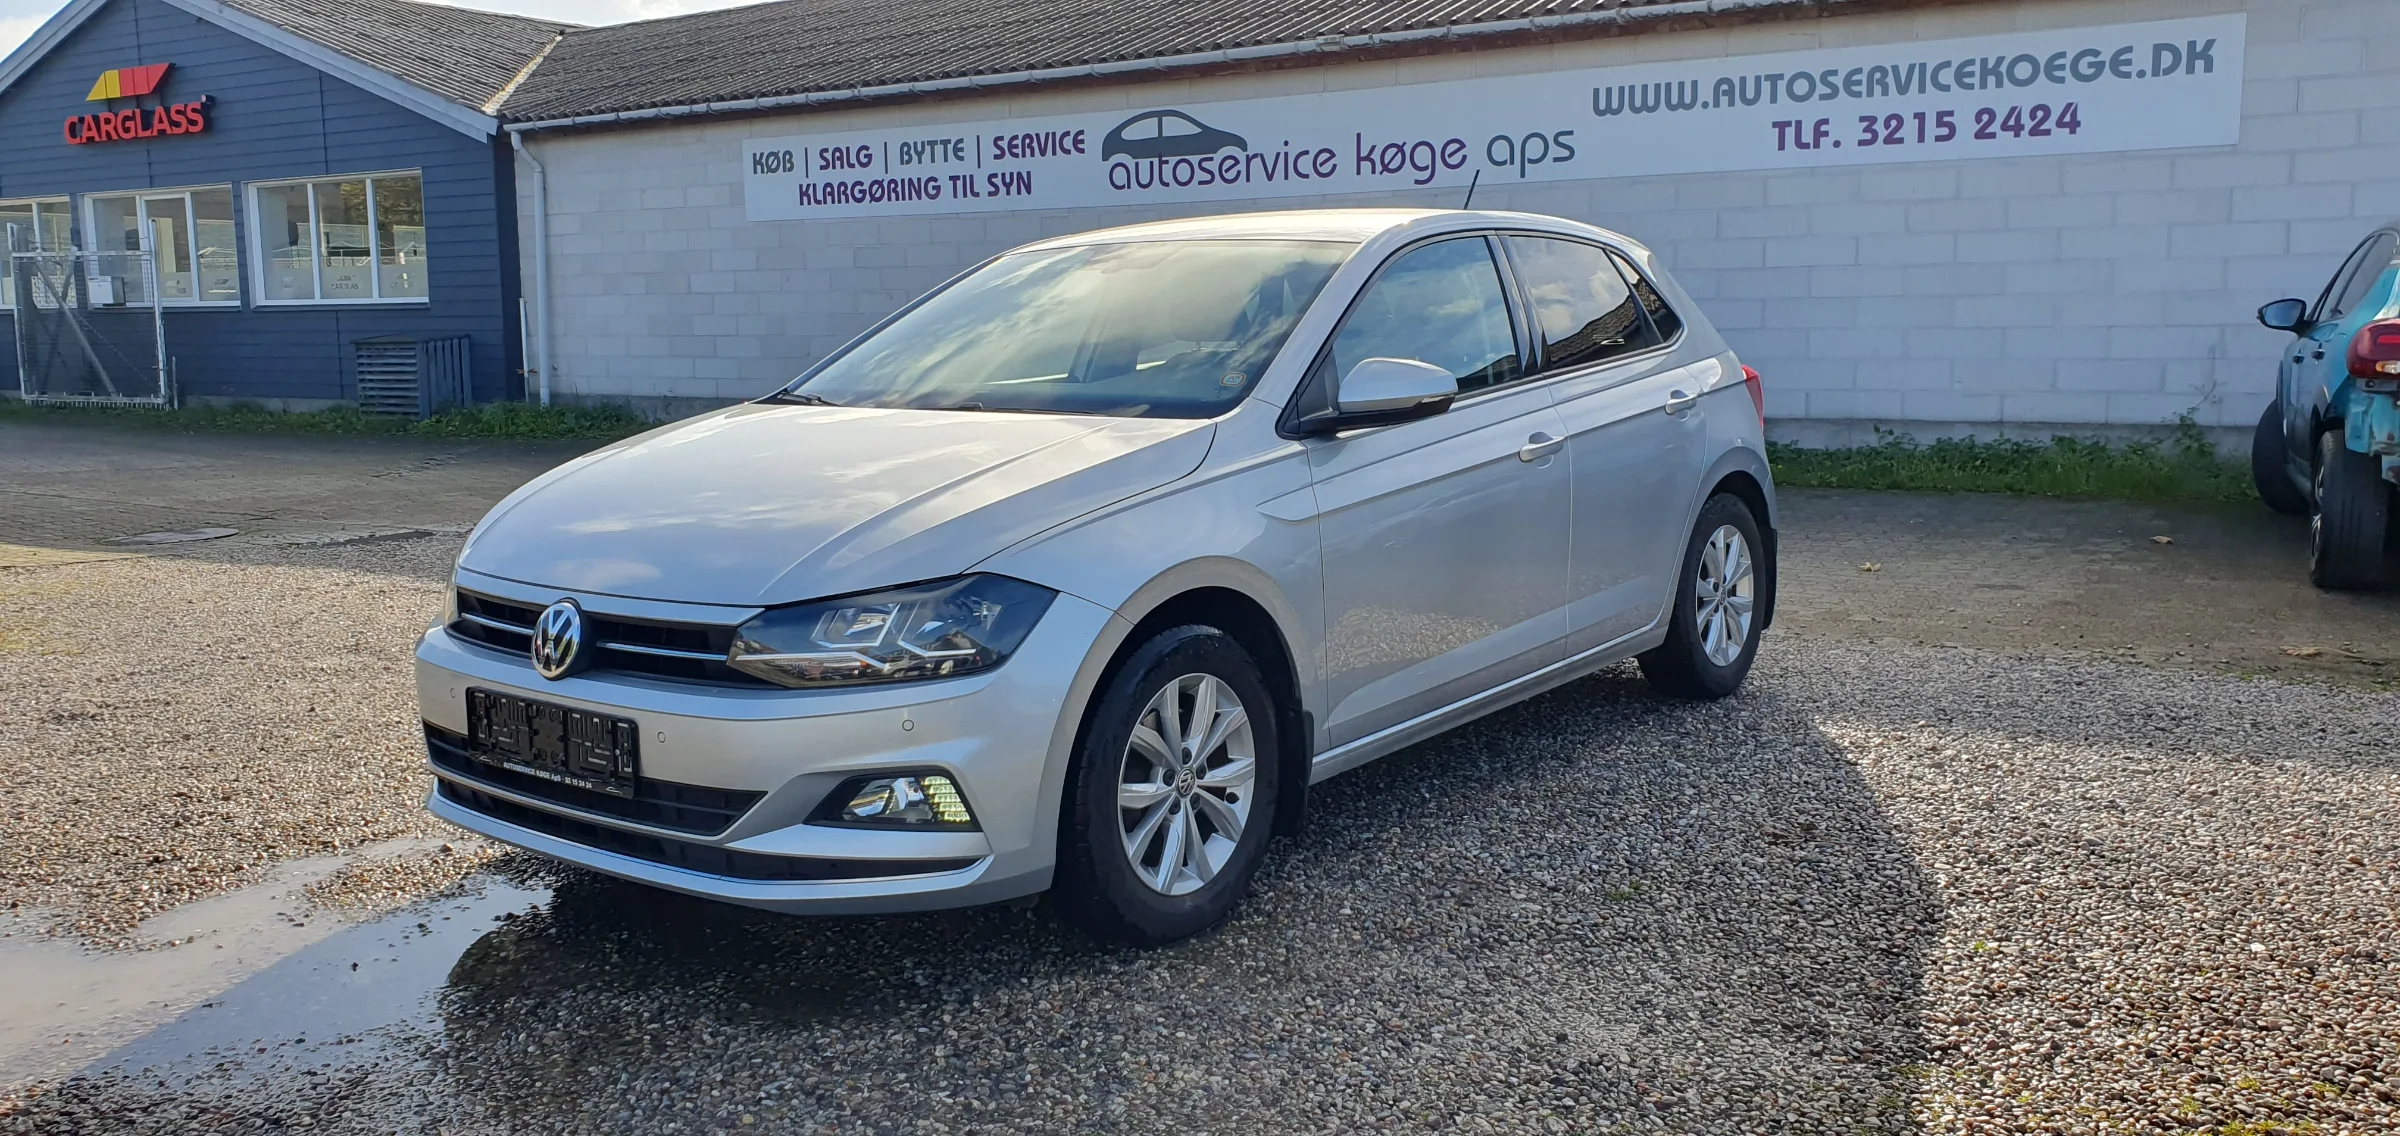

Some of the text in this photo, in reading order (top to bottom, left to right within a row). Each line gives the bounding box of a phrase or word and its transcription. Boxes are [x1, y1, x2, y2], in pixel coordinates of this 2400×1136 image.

[1593, 38, 2216, 117] WWW.AUTOSERVICEKOEGE.DK
[63, 101, 205, 145] CARGLASS
[1772, 101, 2082, 152] TLF. 3215 2424
[753, 150, 795, 175] KØB
[819, 145, 873, 171] SALG
[900, 138, 965, 166] BYTTE
[993, 129, 1086, 160] SERVICE
[1108, 129, 1576, 190] autoservice køge aps
[799, 171, 1032, 206] KLARGØRING TIL SYN
